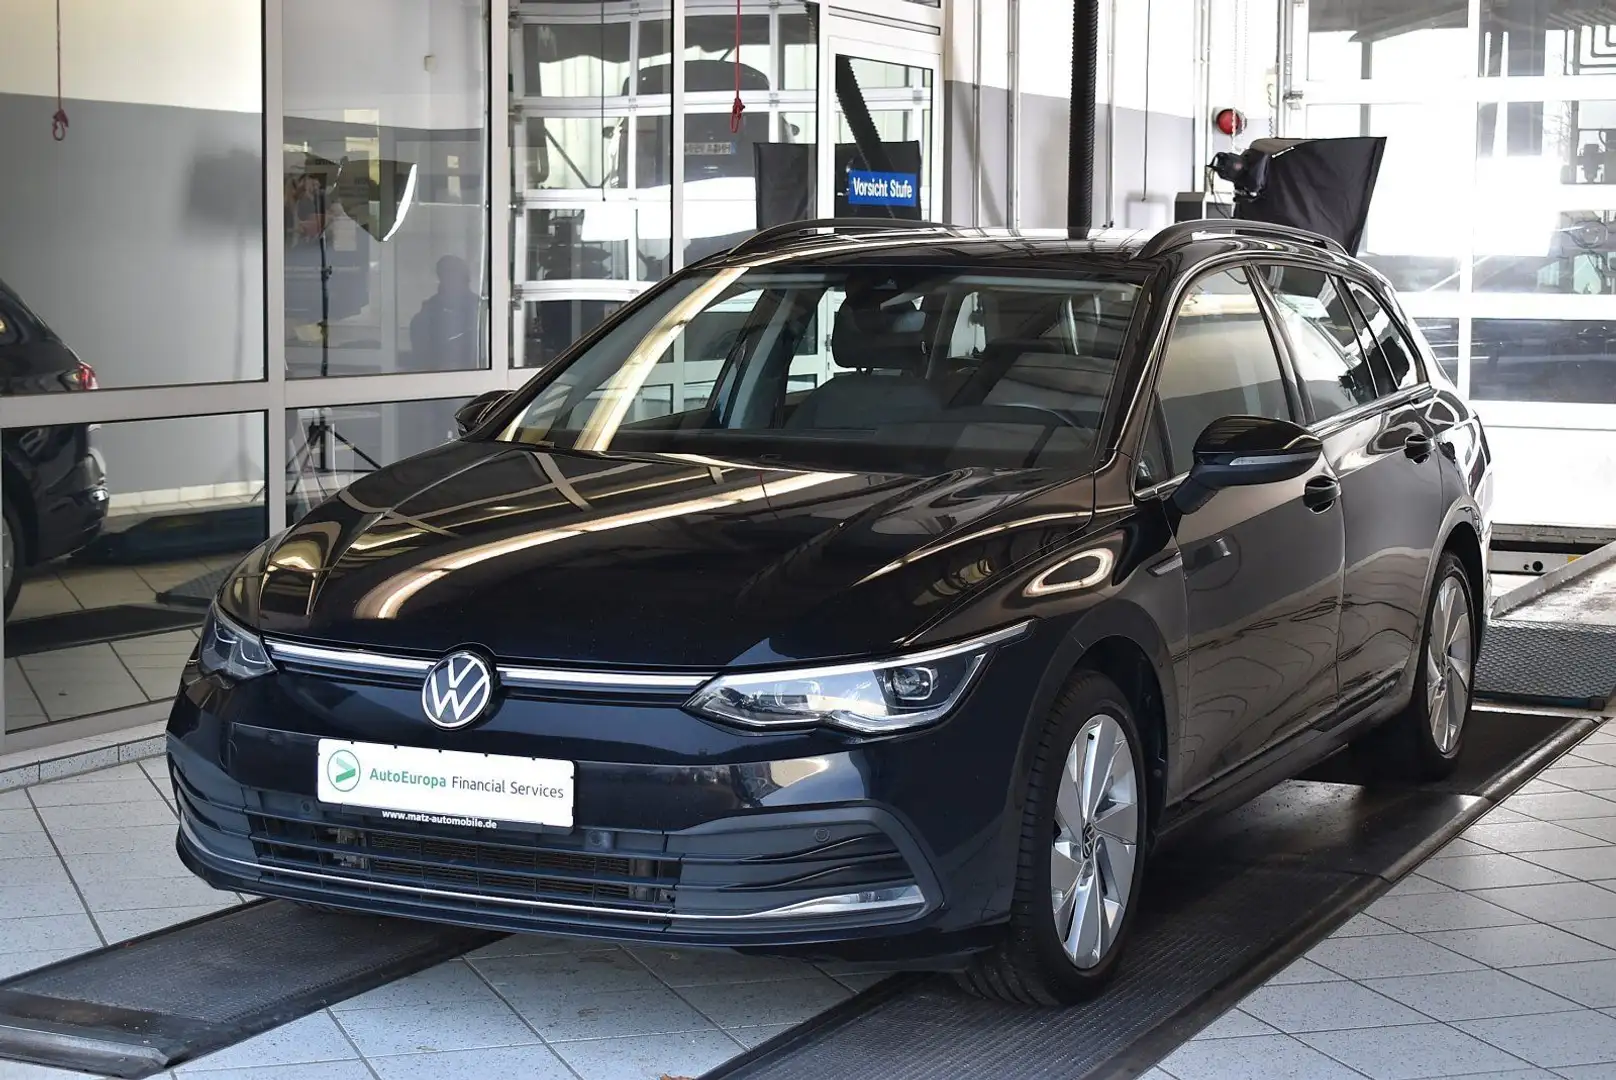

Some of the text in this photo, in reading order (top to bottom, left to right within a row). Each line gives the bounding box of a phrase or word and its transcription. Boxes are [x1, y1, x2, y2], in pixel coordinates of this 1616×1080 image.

[853, 177, 913, 199] Vorsicht Stufe
[426, 652, 491, 722] VW
[369, 767, 565, 799] AutoEuropa Financial Services
[381, 809, 498, 830] www.matz-automobile.de
